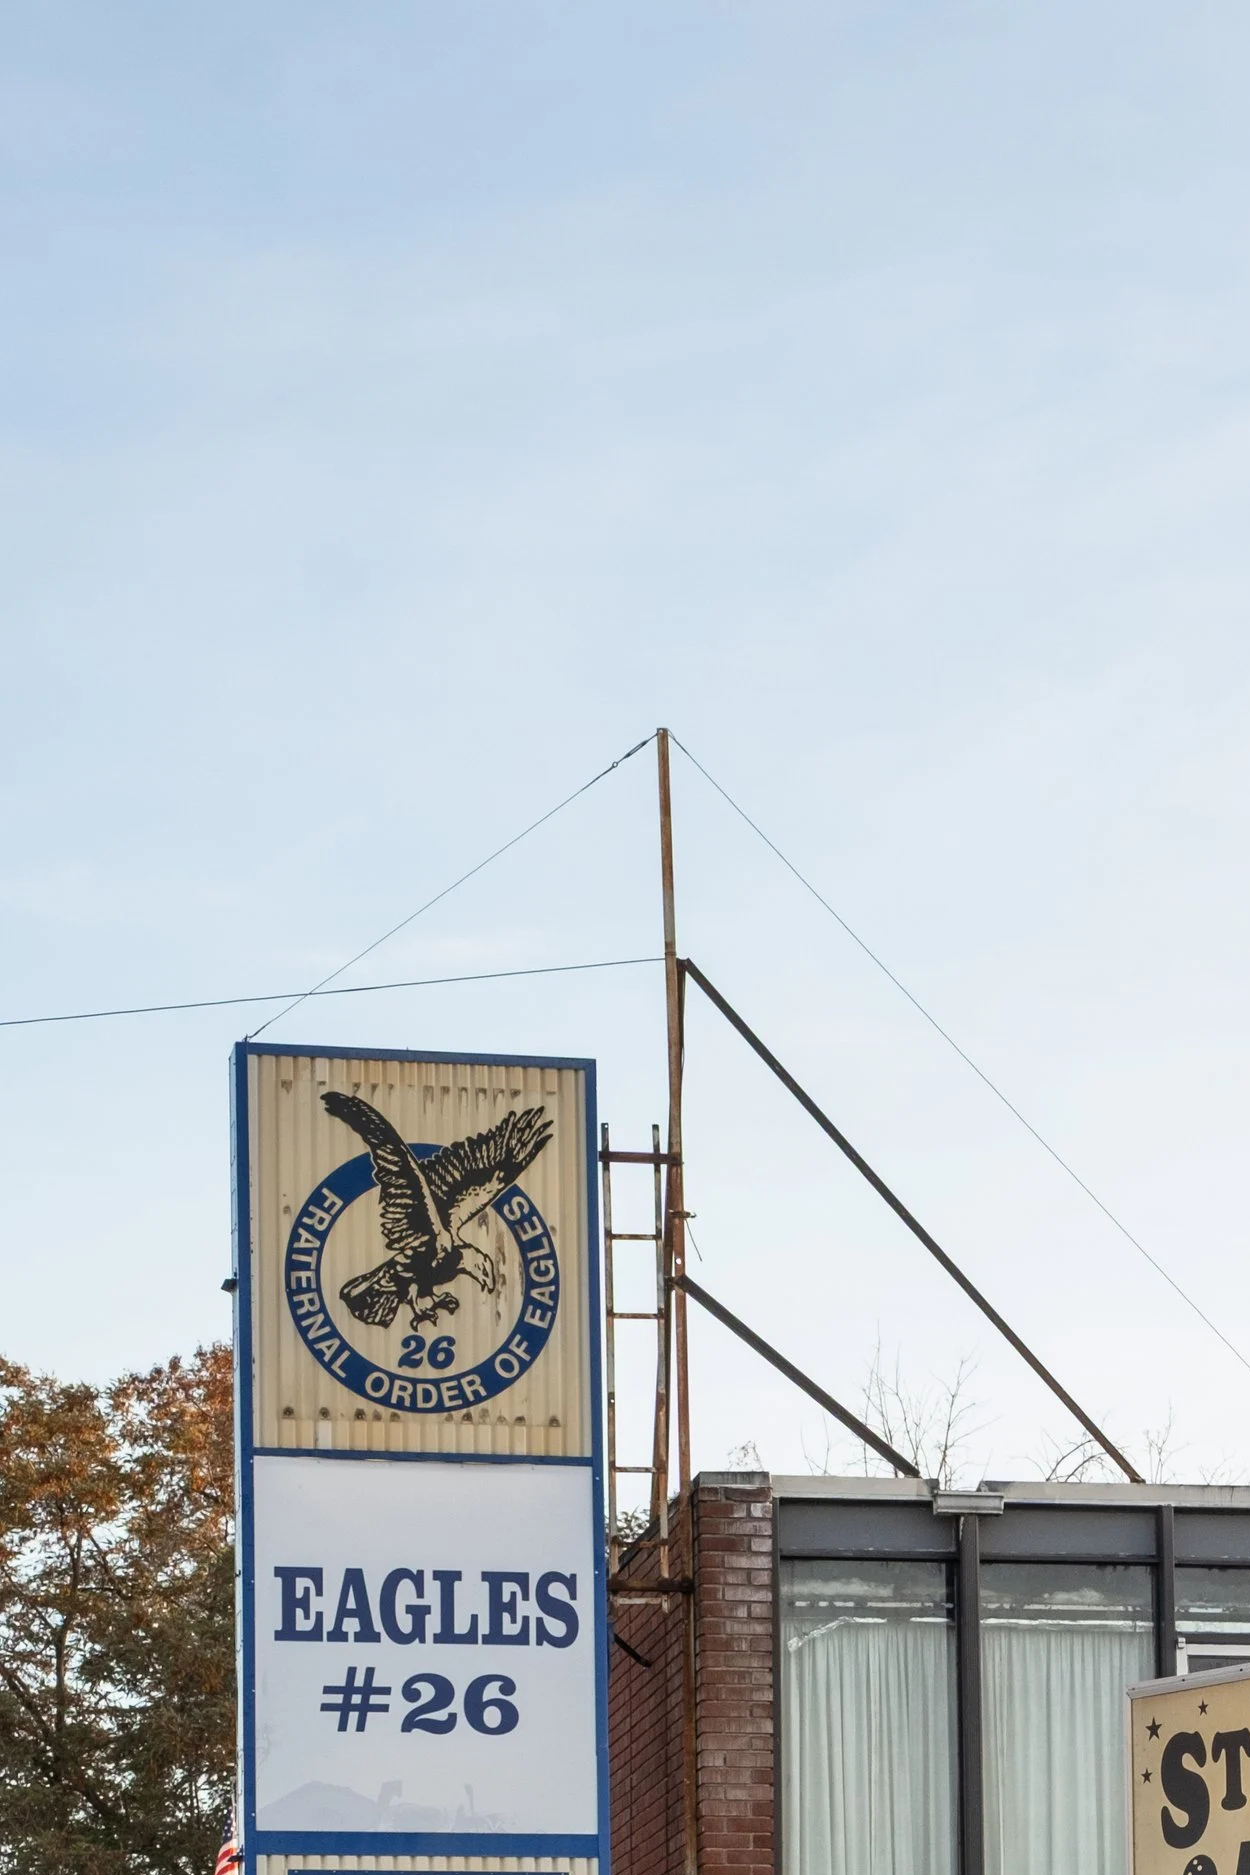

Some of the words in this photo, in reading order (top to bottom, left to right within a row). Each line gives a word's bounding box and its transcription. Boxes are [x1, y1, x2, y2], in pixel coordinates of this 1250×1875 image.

[289, 1187, 349, 1379] FRATERNAL
[503, 1194, 557, 1330] EAGLES
[397, 1333, 457, 1371] 26
[494, 1339, 533, 1380] OF
[364, 1371, 488, 1409] ORDER
[273, 1565, 580, 1649] EAGLES
[319, 1665, 520, 1736] #26
